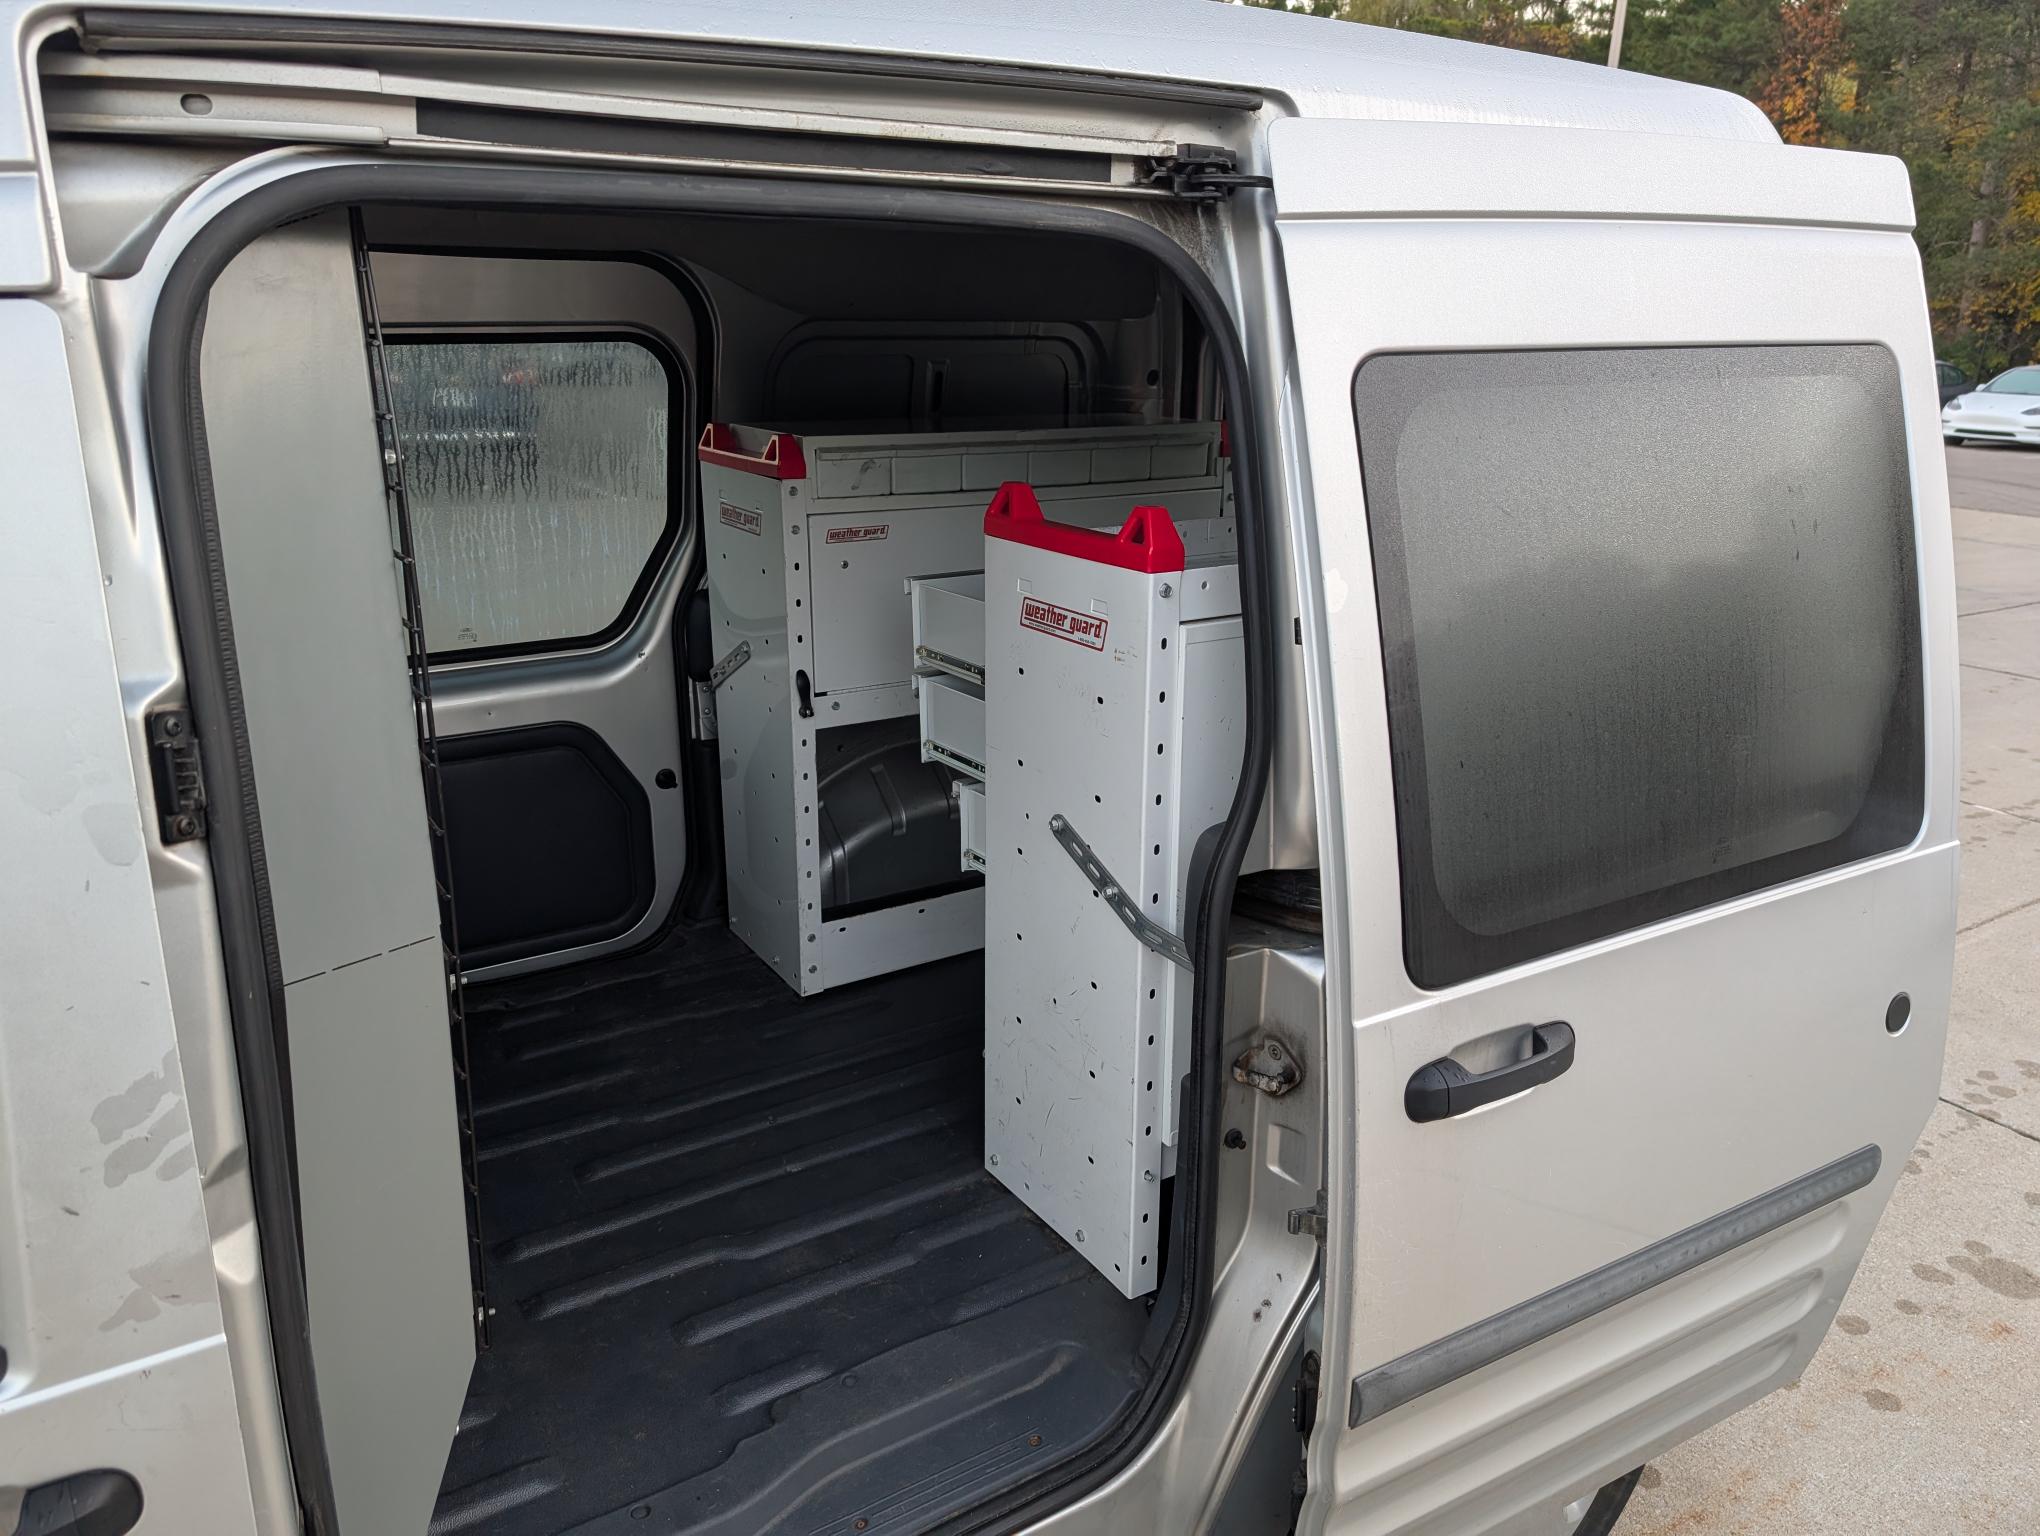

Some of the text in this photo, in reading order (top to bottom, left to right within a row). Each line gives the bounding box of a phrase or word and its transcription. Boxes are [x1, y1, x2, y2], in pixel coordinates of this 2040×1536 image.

[722, 507, 743, 521] weather
[744, 513, 759, 527] guard
[829, 526, 885, 538] weather guard
[1024, 602, 1102, 638] weather guard
